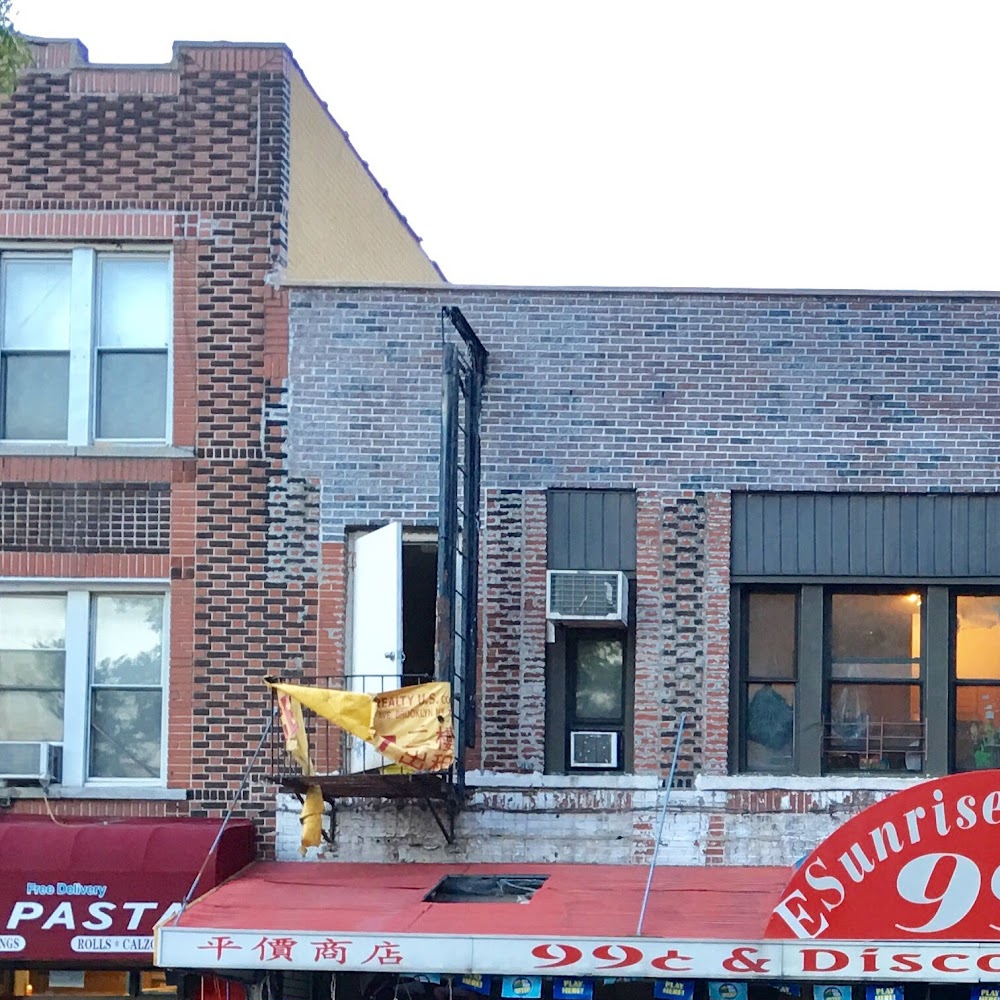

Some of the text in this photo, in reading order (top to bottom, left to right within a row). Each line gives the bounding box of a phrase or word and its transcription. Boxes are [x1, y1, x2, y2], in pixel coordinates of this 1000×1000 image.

[26, 882, 107, 898] Free Delivery
[77, 938, 112, 950] ROLLS
[196, 936, 404, 966] 平價商店
[721, 947, 771, 973] &
[875, 987, 894, 995] PLAY
[981, 988, 1000, 996] PLAY
